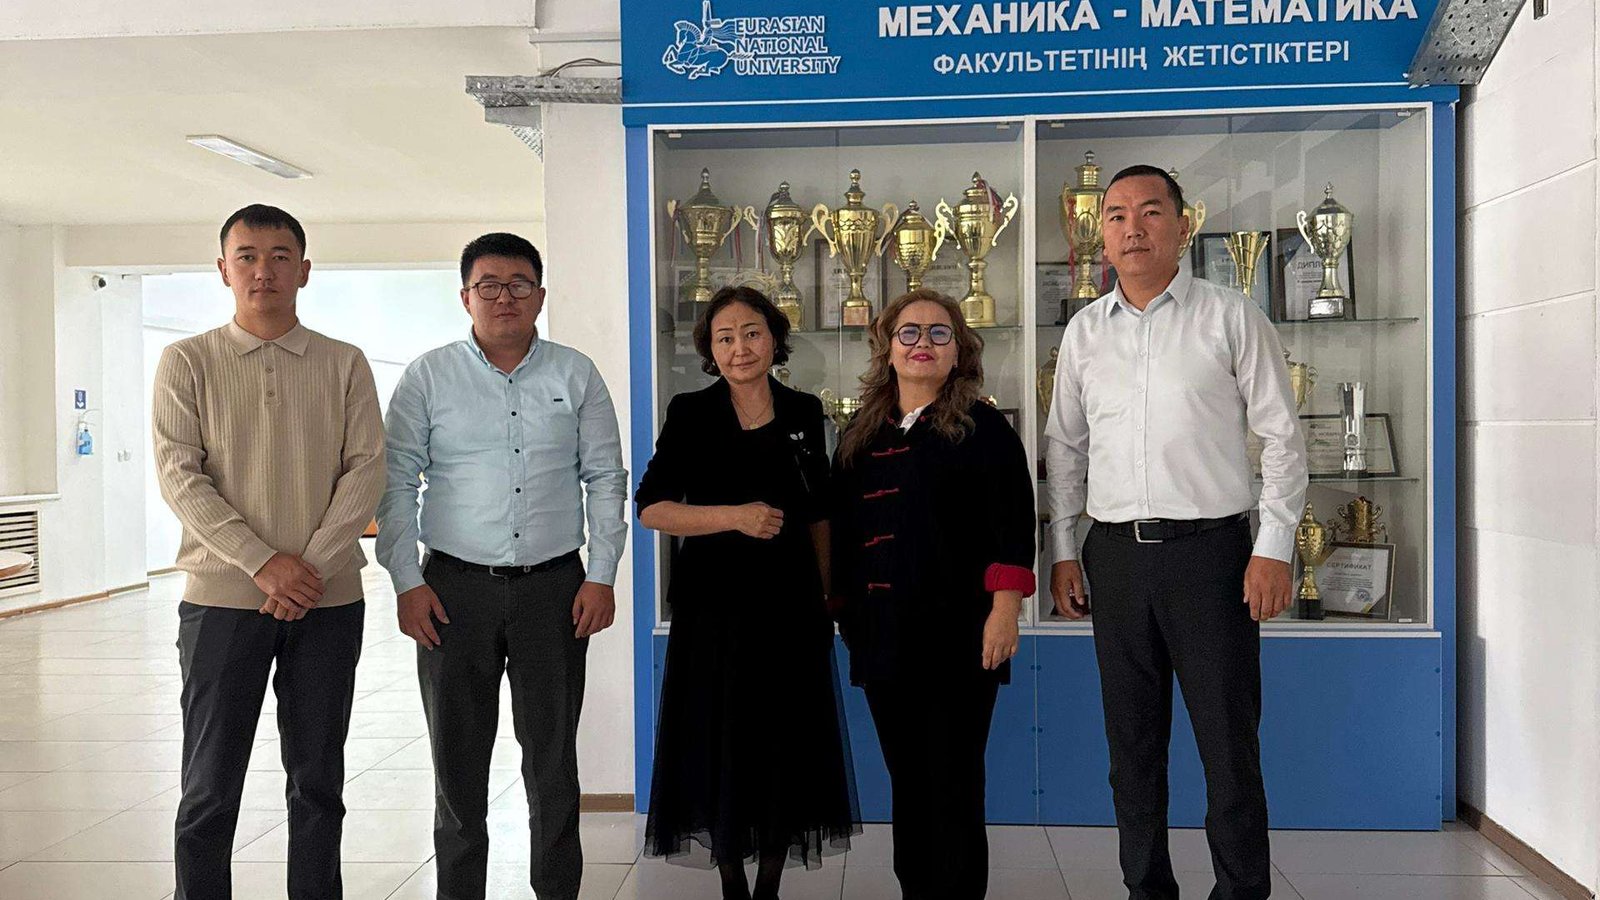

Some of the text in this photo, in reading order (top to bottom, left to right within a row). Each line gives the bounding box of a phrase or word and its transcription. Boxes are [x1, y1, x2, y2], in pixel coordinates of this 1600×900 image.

[734, 15, 825, 35] EURASIAN
[878, 0, 1101, 38] МЕХАНИКА
[1141, 0, 1419, 29] МАТЕМАТИКА
[735, 36, 829, 55] NATIONAL
[734, 55, 842, 76] UNIVERSITY
[933, 40, 1349, 75] ФАКУЛЬТЕТІНІҢ ЖЕТІСТІКТЕРІ
[1297, 261, 1321, 270] ДИПЛ
